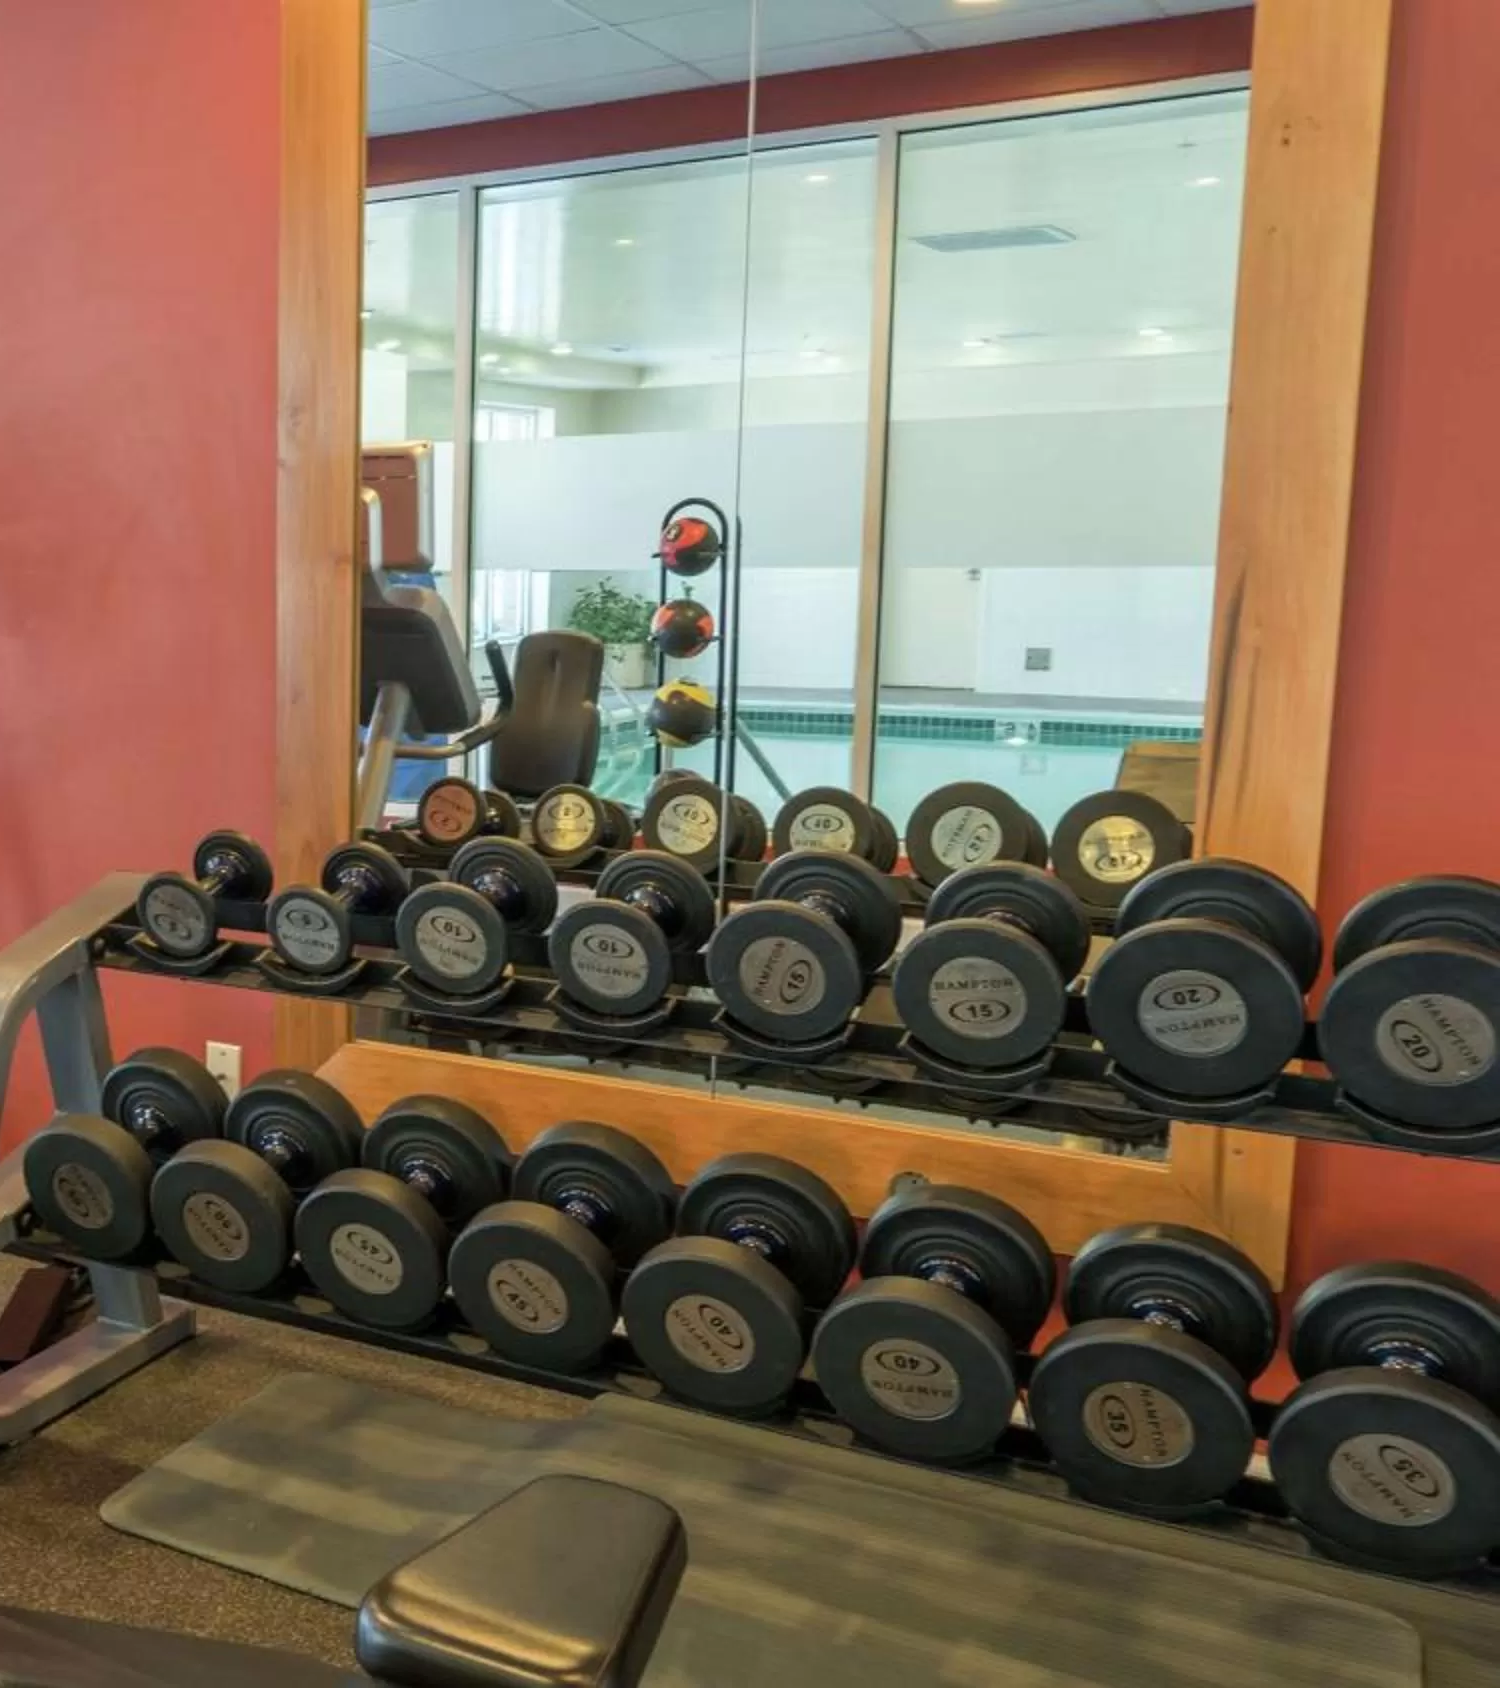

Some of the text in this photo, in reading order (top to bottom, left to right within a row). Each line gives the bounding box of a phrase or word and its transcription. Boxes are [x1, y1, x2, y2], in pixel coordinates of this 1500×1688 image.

[442, 921, 463, 937] 10
[597, 939, 618, 954] 10
[754, 941, 786, 996] HAMPTON
[786, 969, 804, 990] 15
[933, 978, 1013, 990] HAMPTON
[1171, 989, 1200, 1006] 20
[965, 1004, 992, 1018] 15
[1155, 1014, 1241, 1034] HAMPTON
[1417, 997, 1481, 1067] HAMPTON
[1398, 1034, 1428, 1060] 20
[710, 1316, 733, 1337] 40
[673, 1309, 727, 1368] HAMPTON
[894, 1355, 920, 1371] 40
[872, 1379, 953, 1399] HAMPTON
[1107, 1410, 1129, 1434] 35
[1139, 1388, 1169, 1458] HAMPTON
[1394, 1458, 1427, 1484] 35
[1344, 1451, 1419, 1519] HAMPTON
